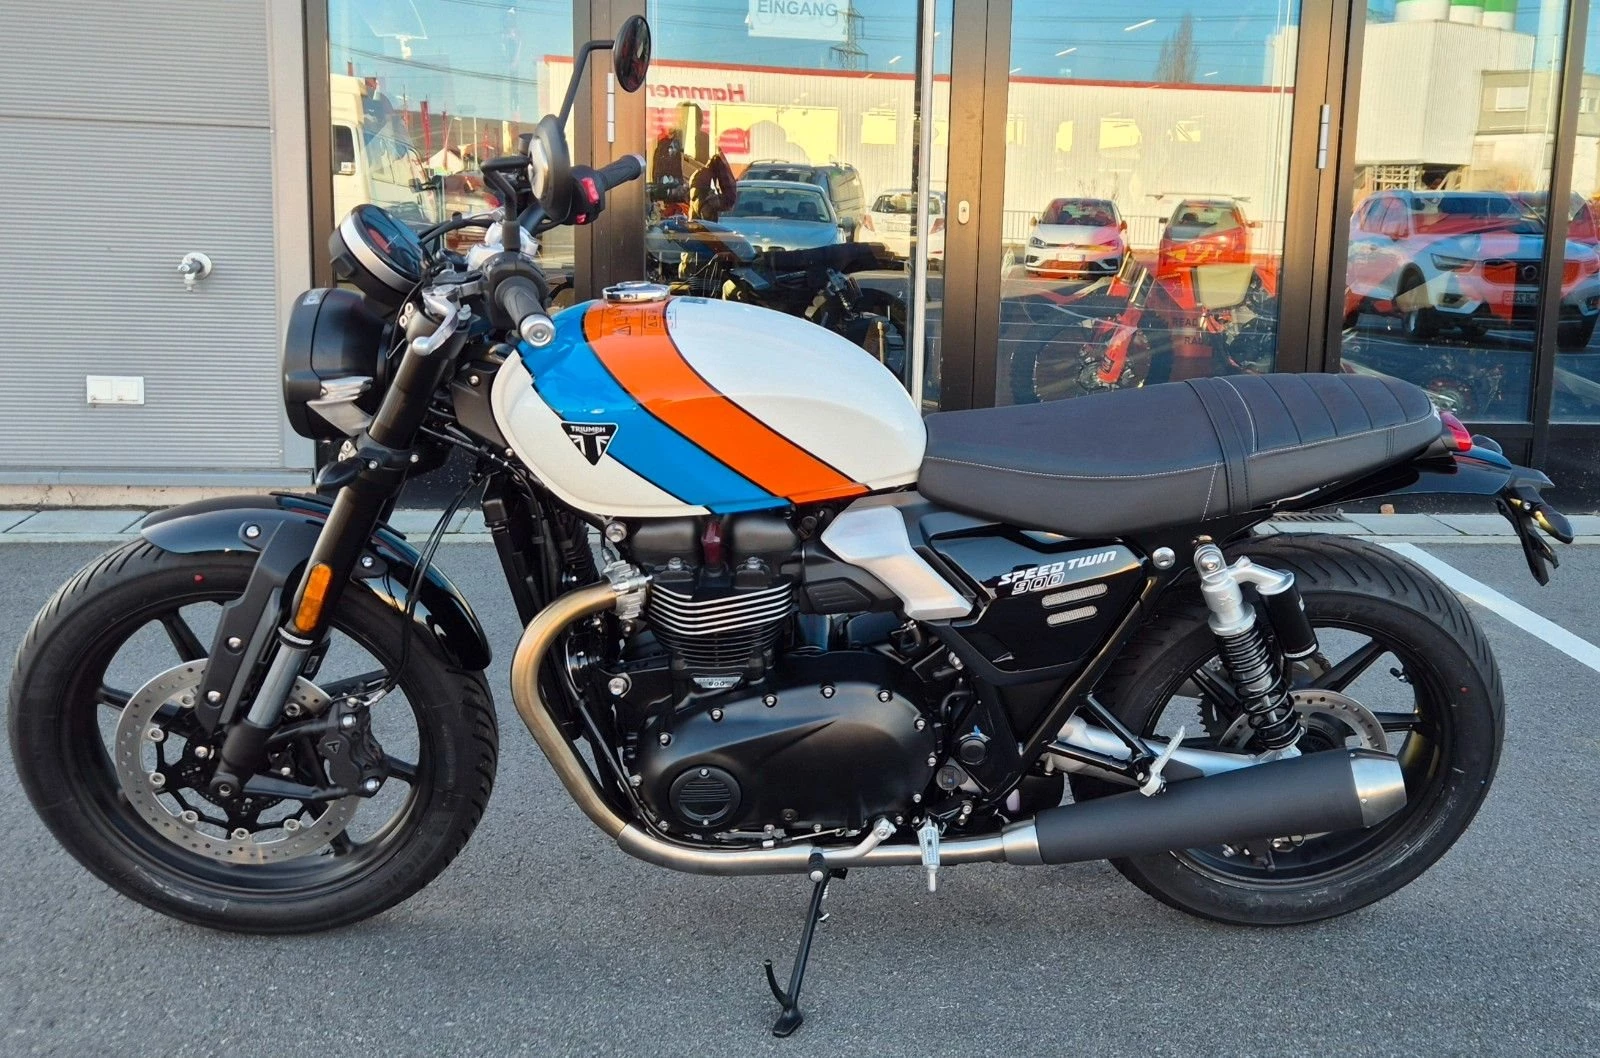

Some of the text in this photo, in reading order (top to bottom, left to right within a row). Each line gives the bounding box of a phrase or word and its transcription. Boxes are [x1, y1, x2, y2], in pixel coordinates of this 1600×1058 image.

[757, 0, 838, 17] EINGANG
[570, 425, 606, 433] TRIUMPH
[998, 551, 1117, 586] SPEED TWIN
[1011, 572, 1065, 595] 900
